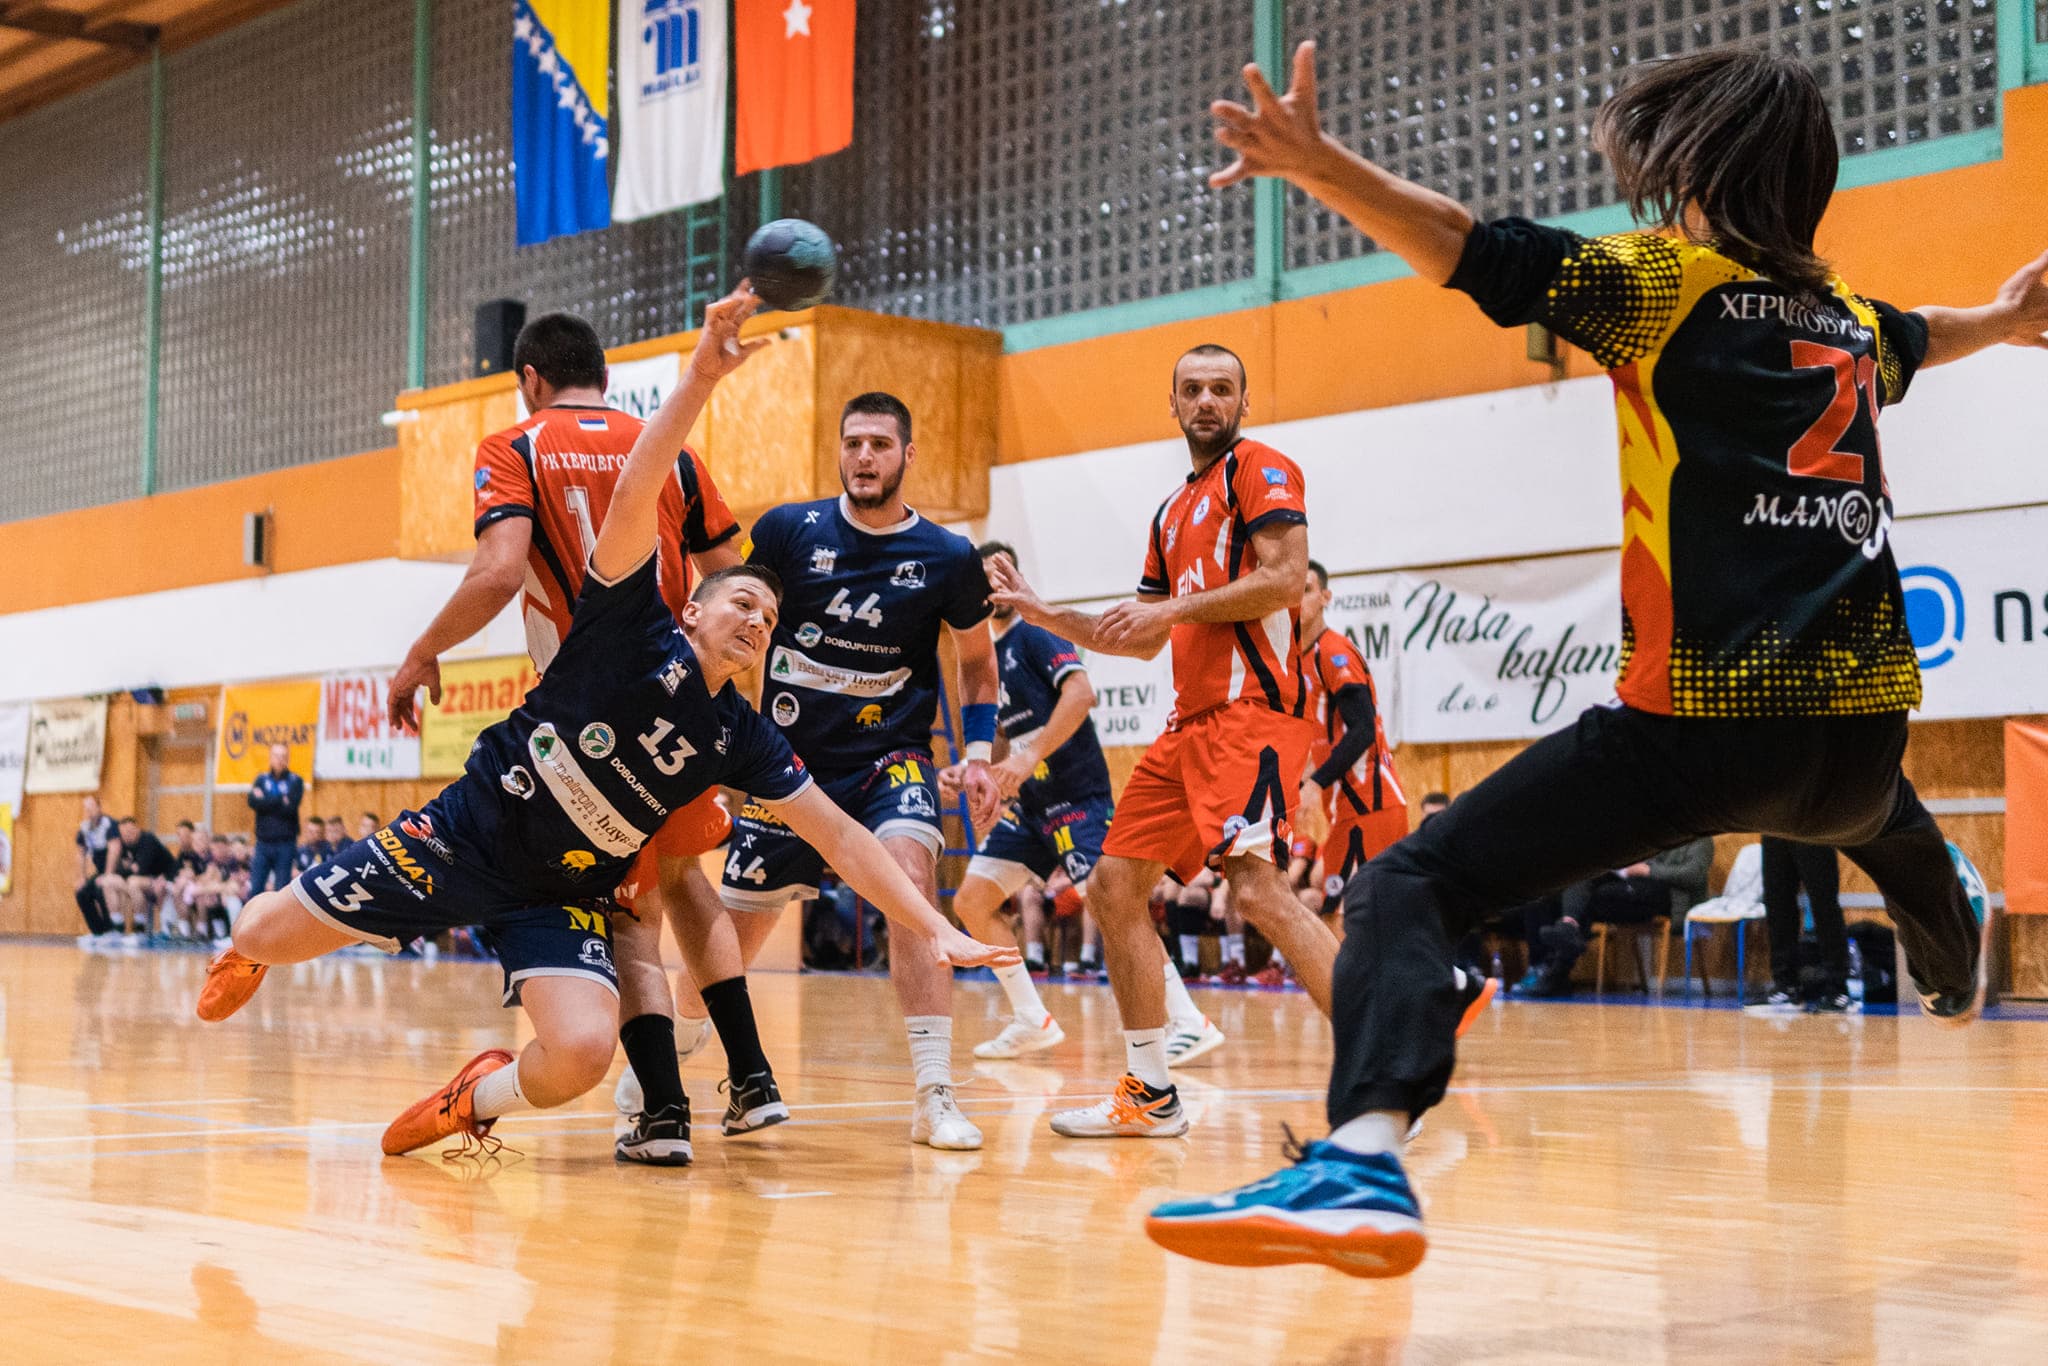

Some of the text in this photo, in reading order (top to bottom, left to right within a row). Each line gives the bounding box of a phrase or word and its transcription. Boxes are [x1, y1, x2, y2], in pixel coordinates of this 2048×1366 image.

[559, 452, 630, 474] ХЕРЦЕГО
[824, 587, 883, 628] 44
[1334, 592, 1391, 610] PIZZERIA
[1404, 579, 1510, 652] Naša
[440, 666, 541, 715] zanat
[1498, 624, 1621, 724] kafan
[1104, 715, 1140, 734] JUG
[637, 716, 698, 776] 13
[886, 759, 926, 788] M
[725, 849, 767, 886] 44
[314, 864, 375, 913] 13
[562, 905, 609, 940] M
